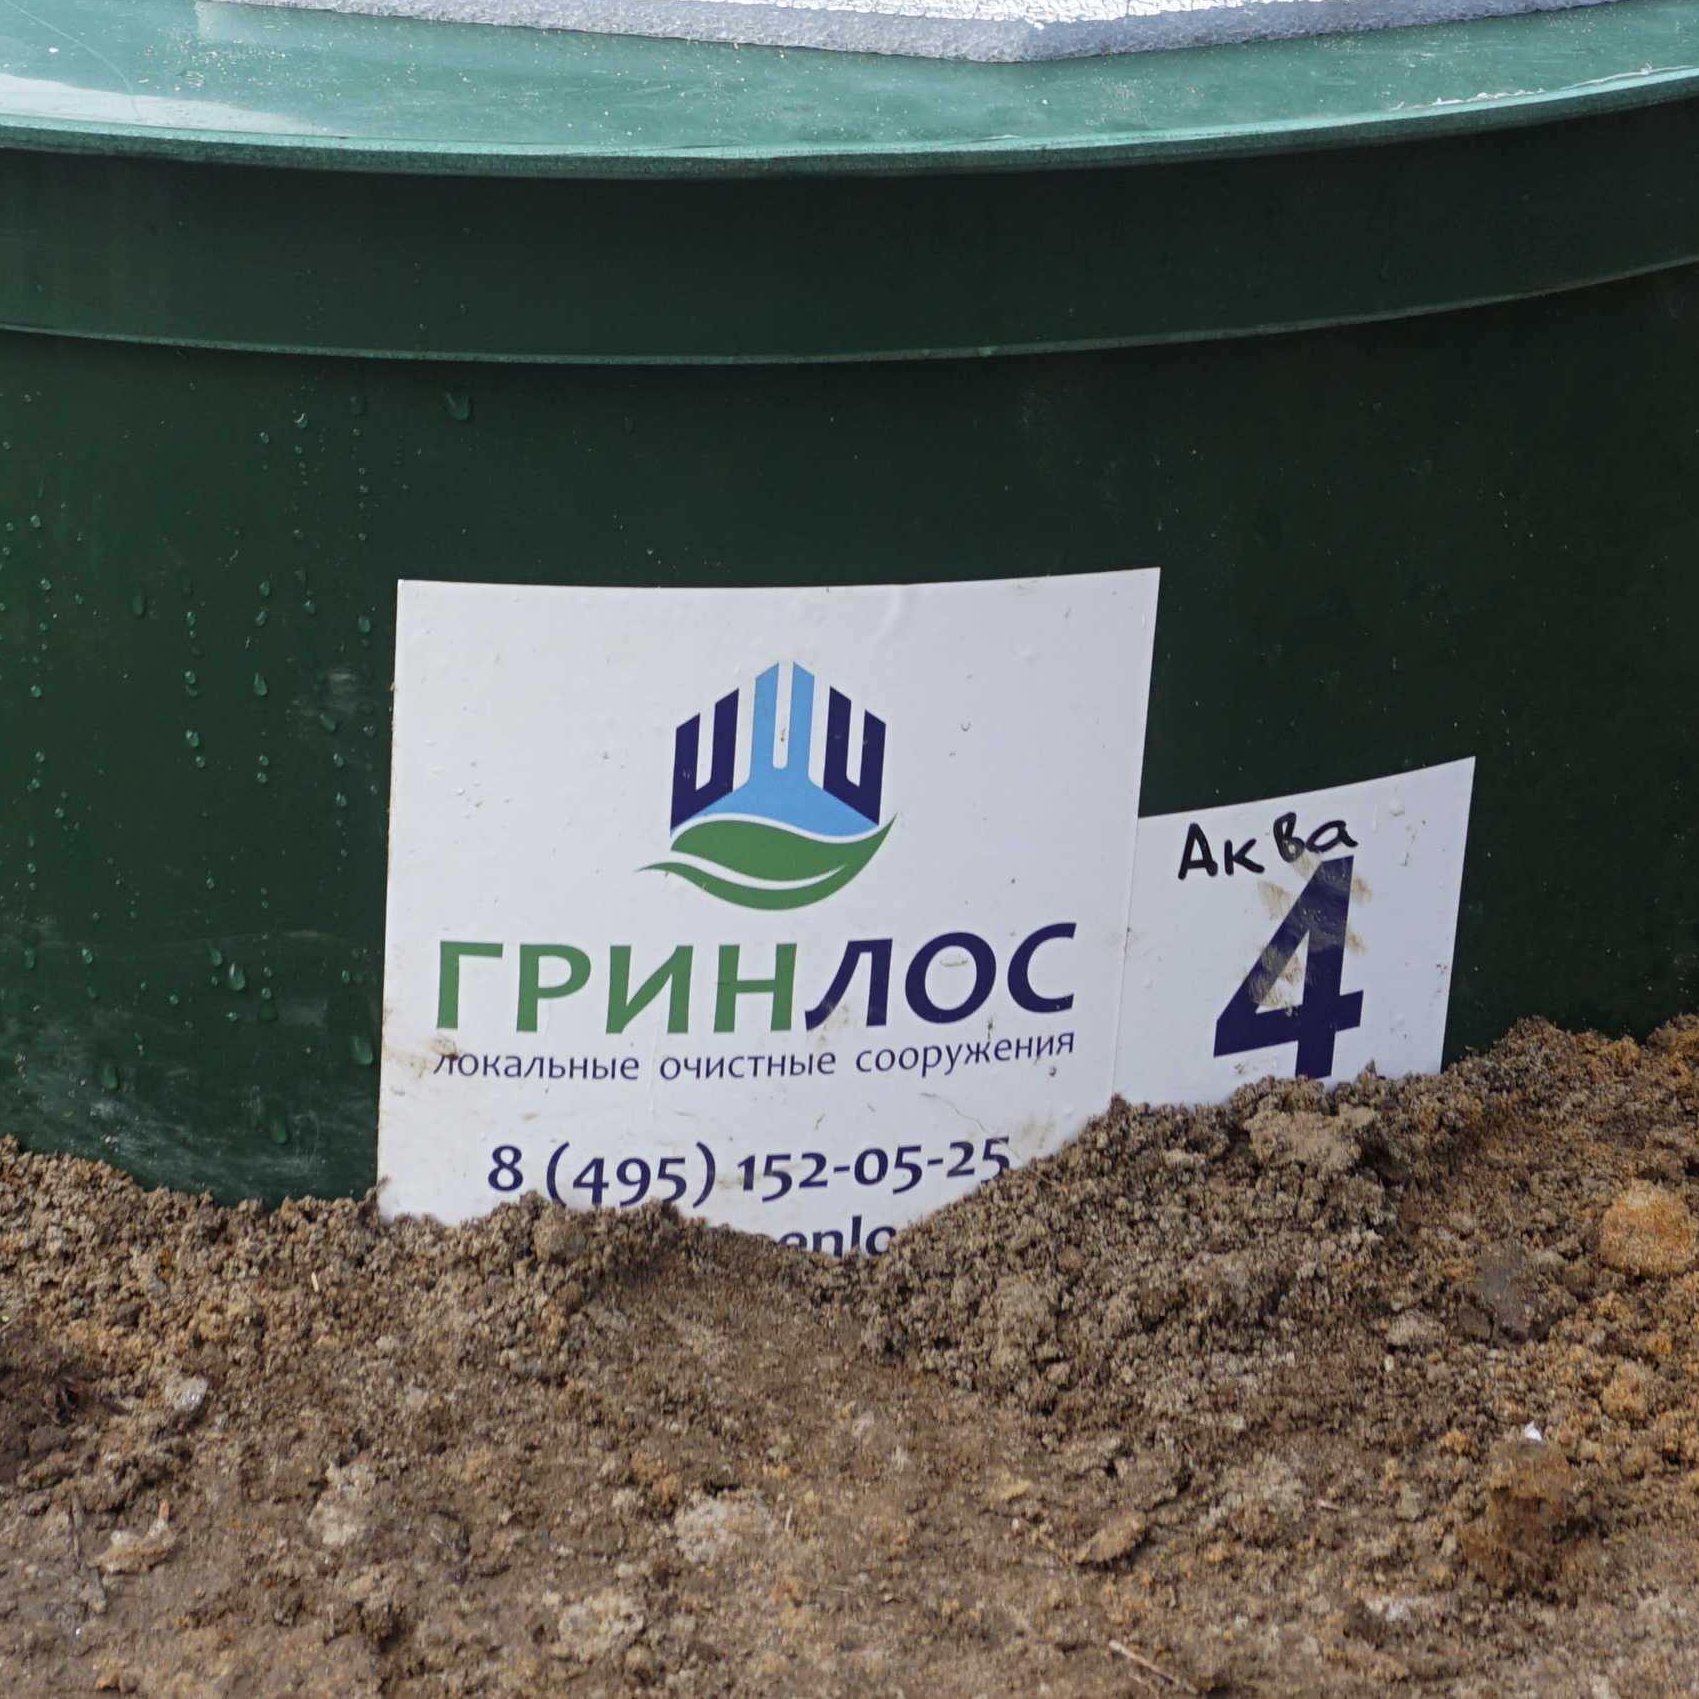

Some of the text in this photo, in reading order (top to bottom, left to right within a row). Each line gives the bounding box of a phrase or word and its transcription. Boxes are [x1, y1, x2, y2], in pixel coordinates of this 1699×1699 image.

[436, 923, 1076, 1033] ГРИНЛОС
[1213, 854, 1364, 1079] 4
[433, 1031, 1075, 1080] локальные очистные сооружения
[488, 1137, 1010, 1209] 8 (495) 152-05-25
